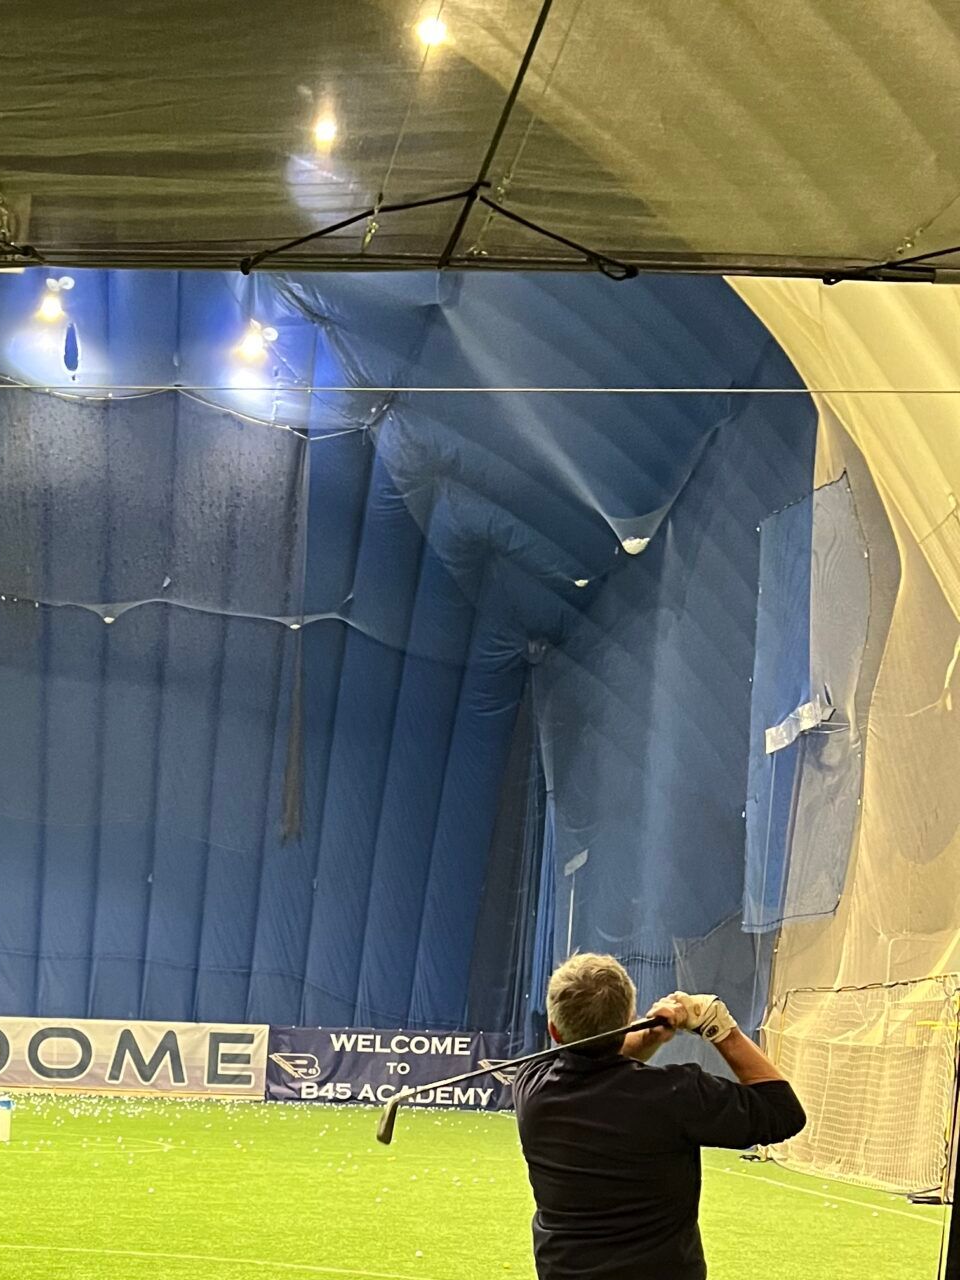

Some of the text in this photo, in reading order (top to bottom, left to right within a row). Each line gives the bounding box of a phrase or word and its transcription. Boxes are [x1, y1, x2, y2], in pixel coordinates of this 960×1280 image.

[330, 1033, 471, 1056] WELCOME
[386, 1062, 411, 1075] TO
[300, 1082, 352, 1100] B45
